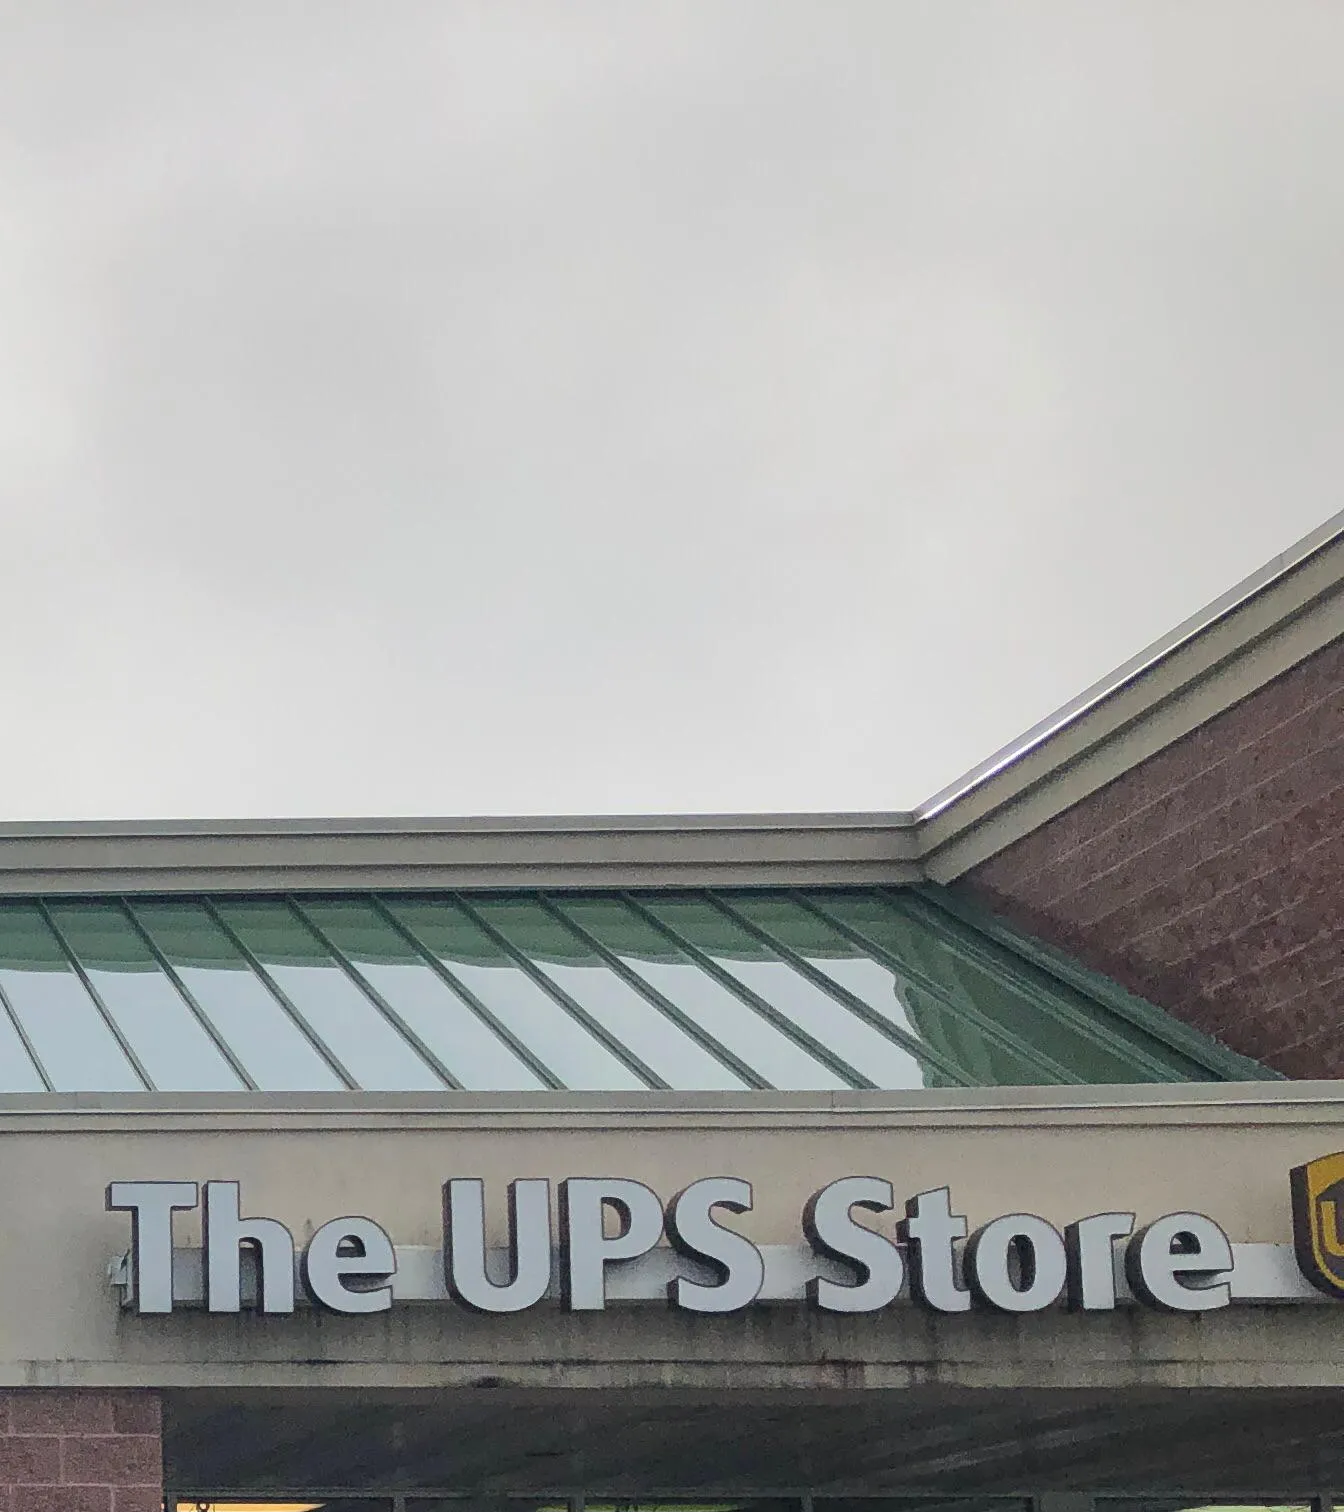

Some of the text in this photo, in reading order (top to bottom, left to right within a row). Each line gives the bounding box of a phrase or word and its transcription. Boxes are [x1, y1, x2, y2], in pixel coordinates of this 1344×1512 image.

[107, 1180, 396, 1313] The
[445, 1177, 765, 1313] UPS
[803, 1175, 1234, 1313] Store
